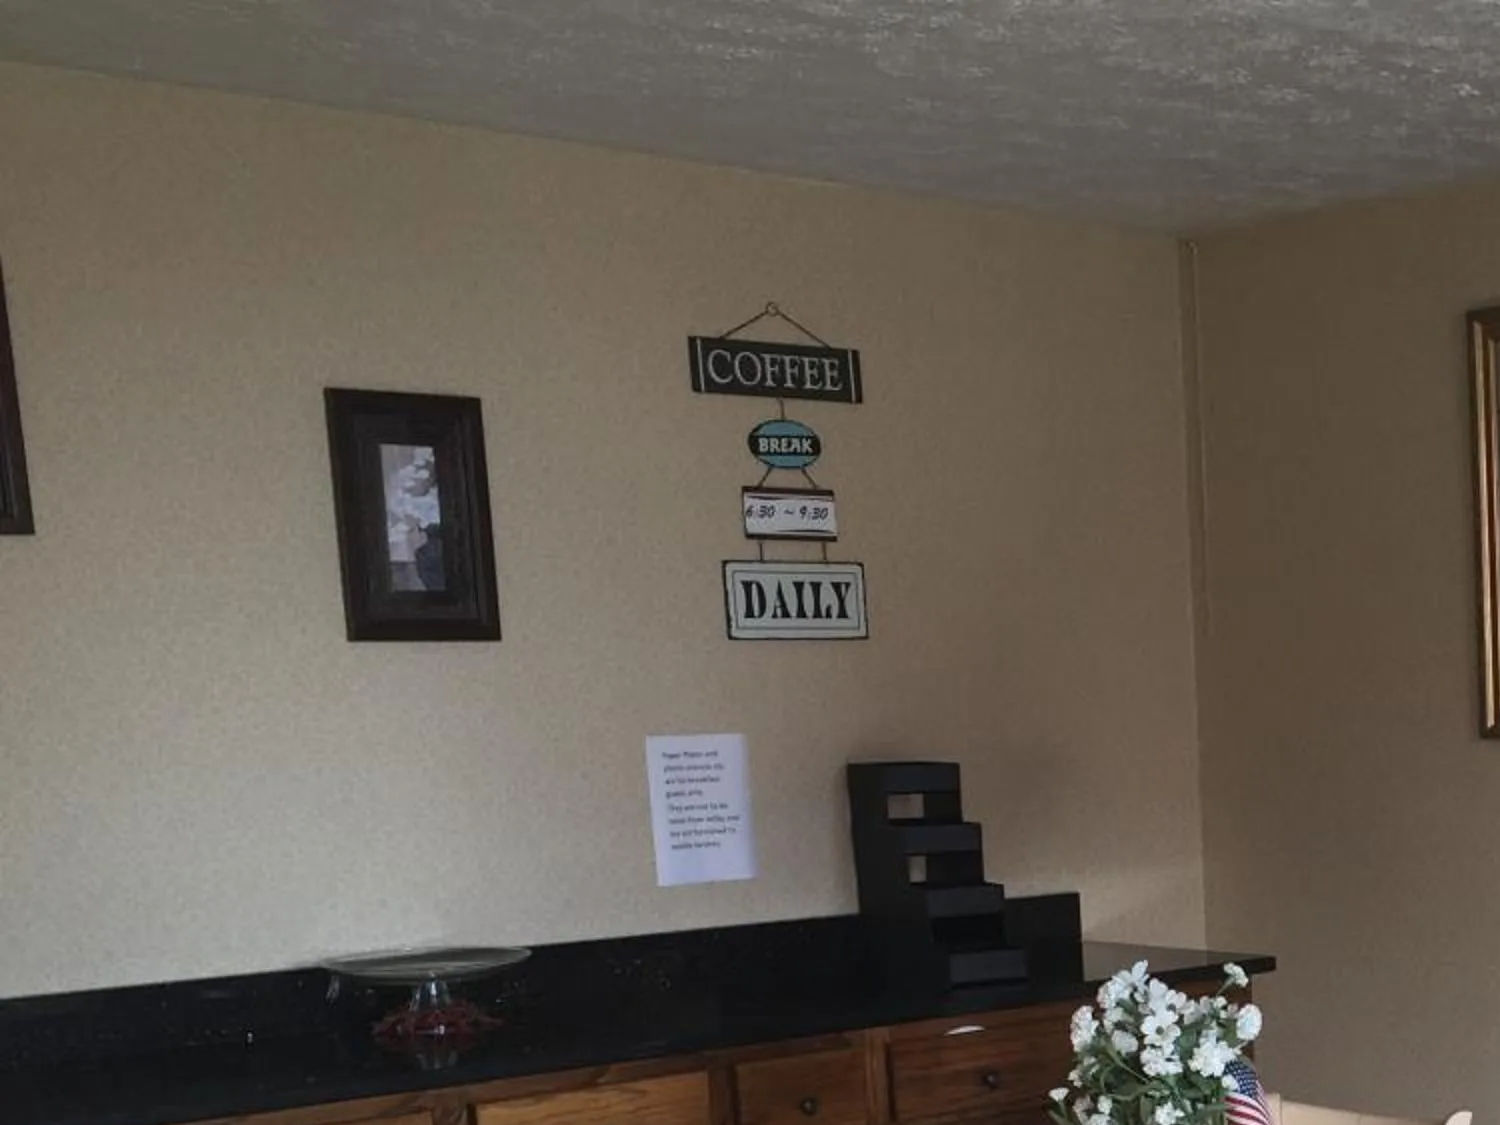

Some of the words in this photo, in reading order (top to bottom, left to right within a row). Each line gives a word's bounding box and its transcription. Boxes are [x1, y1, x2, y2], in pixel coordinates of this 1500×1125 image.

[708, 349, 843, 391] COFFEE
[758, 437, 814, 453] BREAK
[799, 505, 829, 520] 9:30
[741, 580, 852, 619] DAILY
